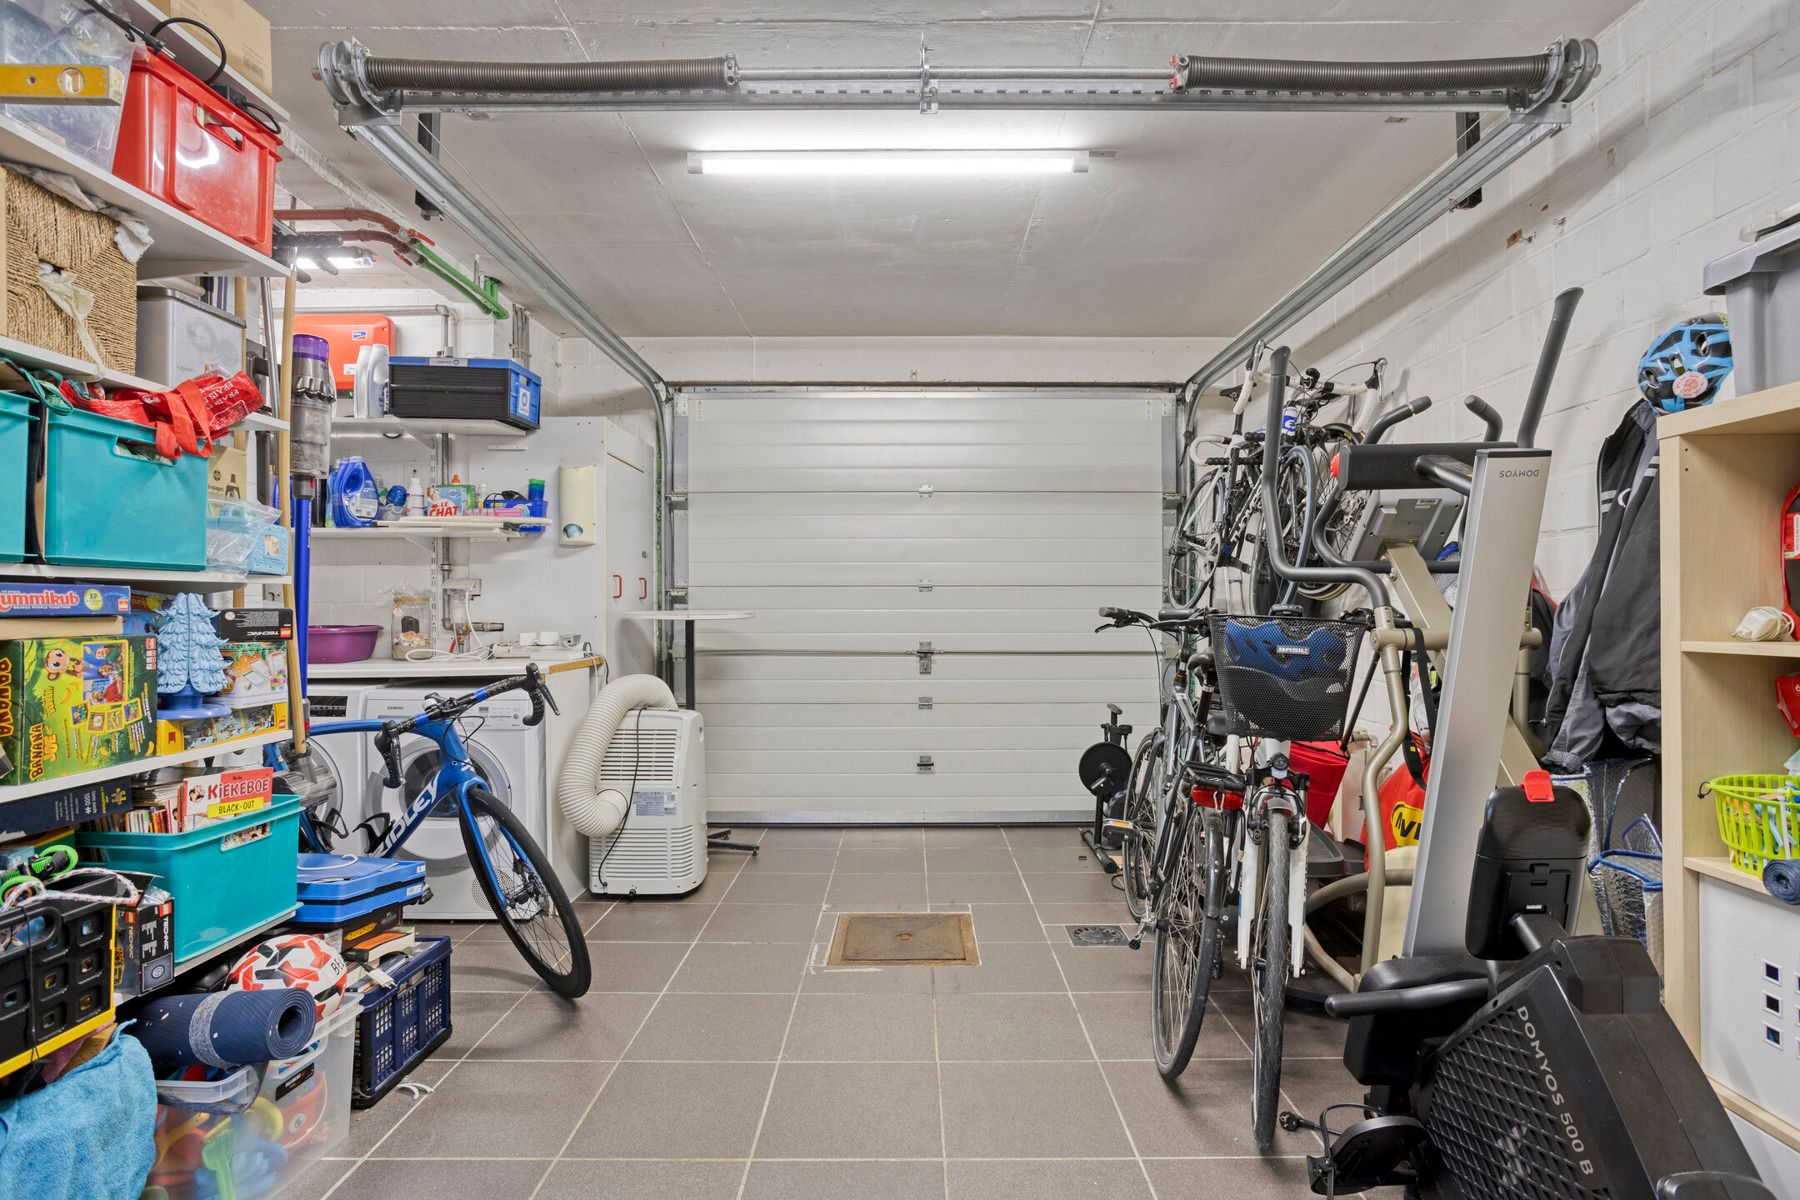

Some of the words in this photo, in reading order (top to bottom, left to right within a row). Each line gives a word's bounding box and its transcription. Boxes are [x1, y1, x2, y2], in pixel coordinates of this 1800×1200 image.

[1499, 469, 1540, 478] DOMYOS
[0, 585, 80, 612] ummikub
[30, 723, 44, 780] BANANA
[218, 799, 256, 815] BLACK-OUT
[1517, 1005, 1565, 1106] DOMYOS
[1560, 1112, 1585, 1153] 500
[1579, 1159, 1594, 1176] B
